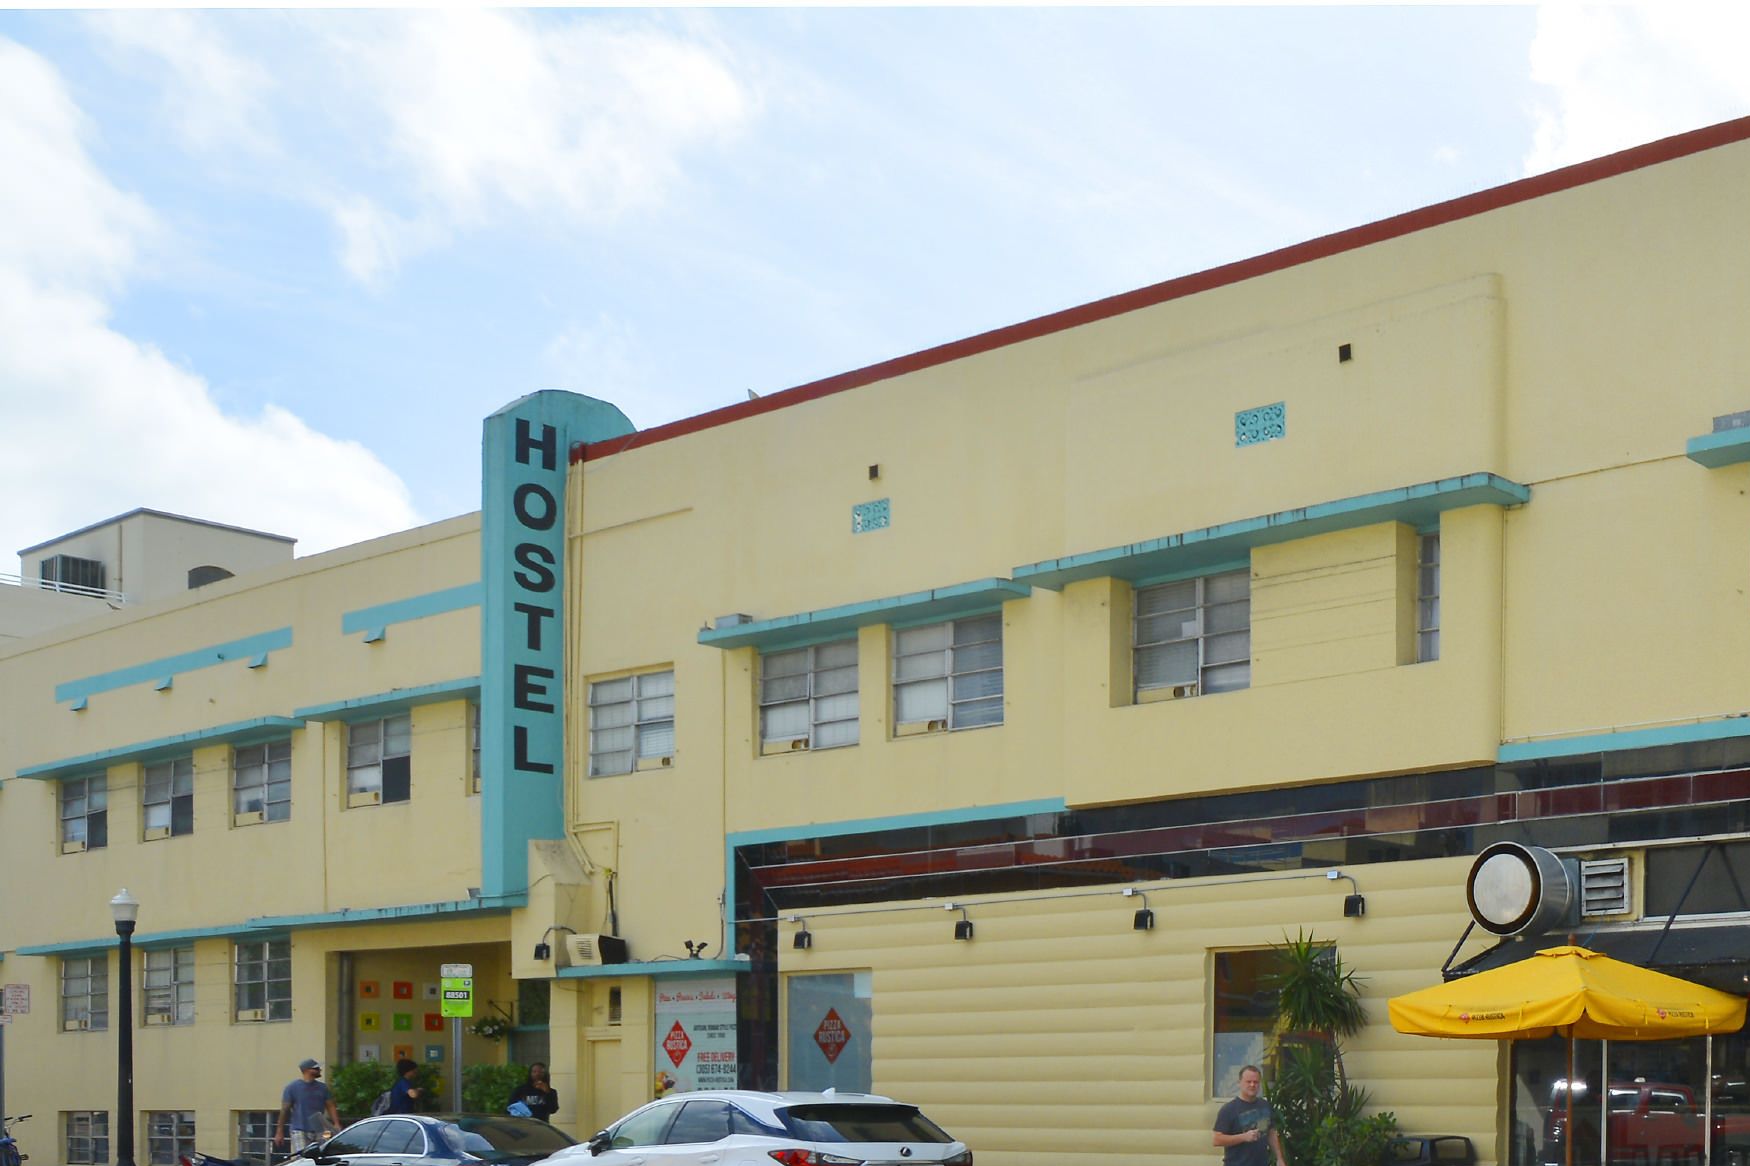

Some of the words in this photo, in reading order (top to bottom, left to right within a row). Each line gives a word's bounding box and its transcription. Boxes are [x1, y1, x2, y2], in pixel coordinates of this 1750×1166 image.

[513, 418, 557, 775] HOSTEL
[824, 1020, 841, 1030] PIZZA
[697, 1052, 709, 1062] FREE
